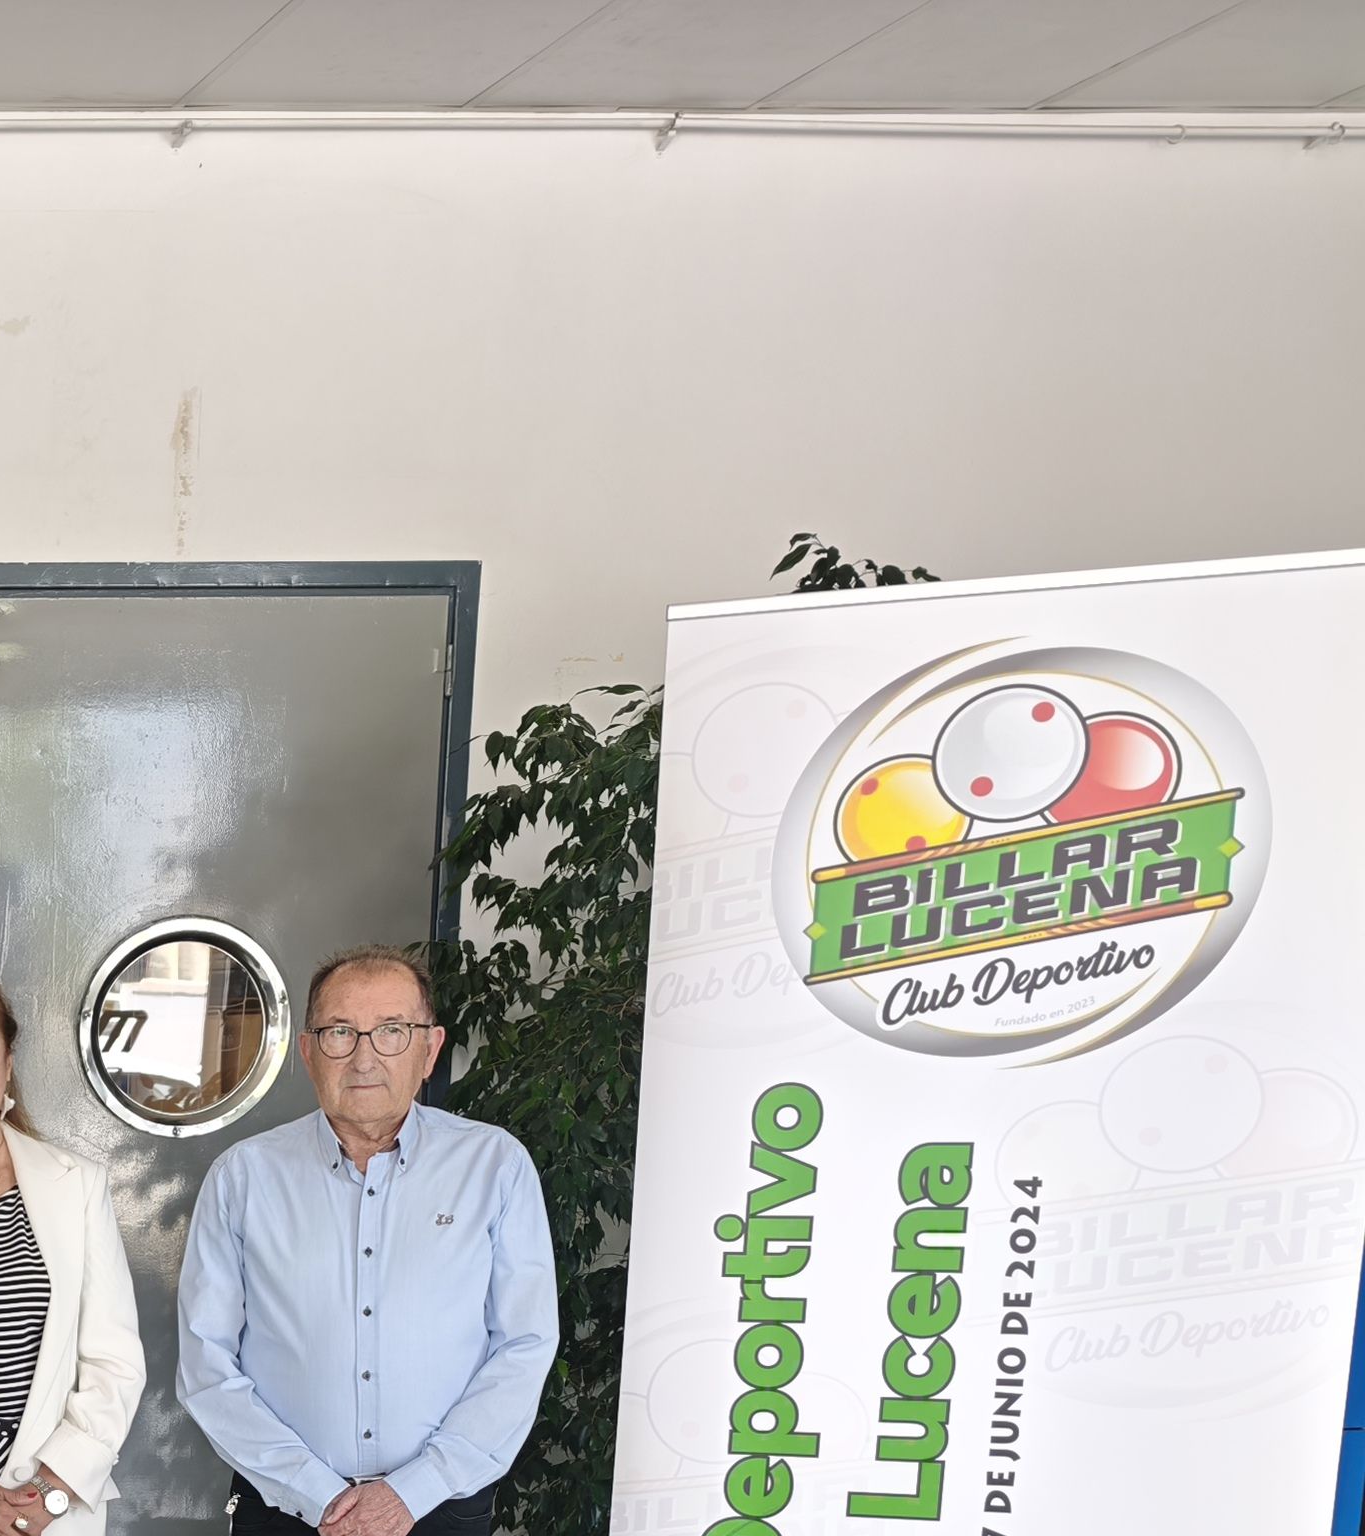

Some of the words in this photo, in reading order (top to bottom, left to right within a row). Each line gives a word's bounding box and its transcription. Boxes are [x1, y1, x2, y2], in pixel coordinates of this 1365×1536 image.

[839, 857, 1199, 961] LUCENA
[853, 819, 1182, 918] BILLAR
[882, 972, 965, 1026] Club
[972, 940, 1155, 1005] Deportivo
[994, 1012, 1047, 1027] Fundado
[1049, 1008, 1064, 1018] en
[1067, 995, 1096, 1014] 2023
[1005, 1176, 1043, 1279] 2024
[846, 1141, 974, 1521] Lucena
[1000, 1292, 1033, 1335] DE
[1044, 1322, 1131, 1373] Club
[1140, 1299, 1331, 1358] Deportivo
[988, 1347, 1027, 1462] JUNIO
[984, 1471, 1016, 1513] DE
